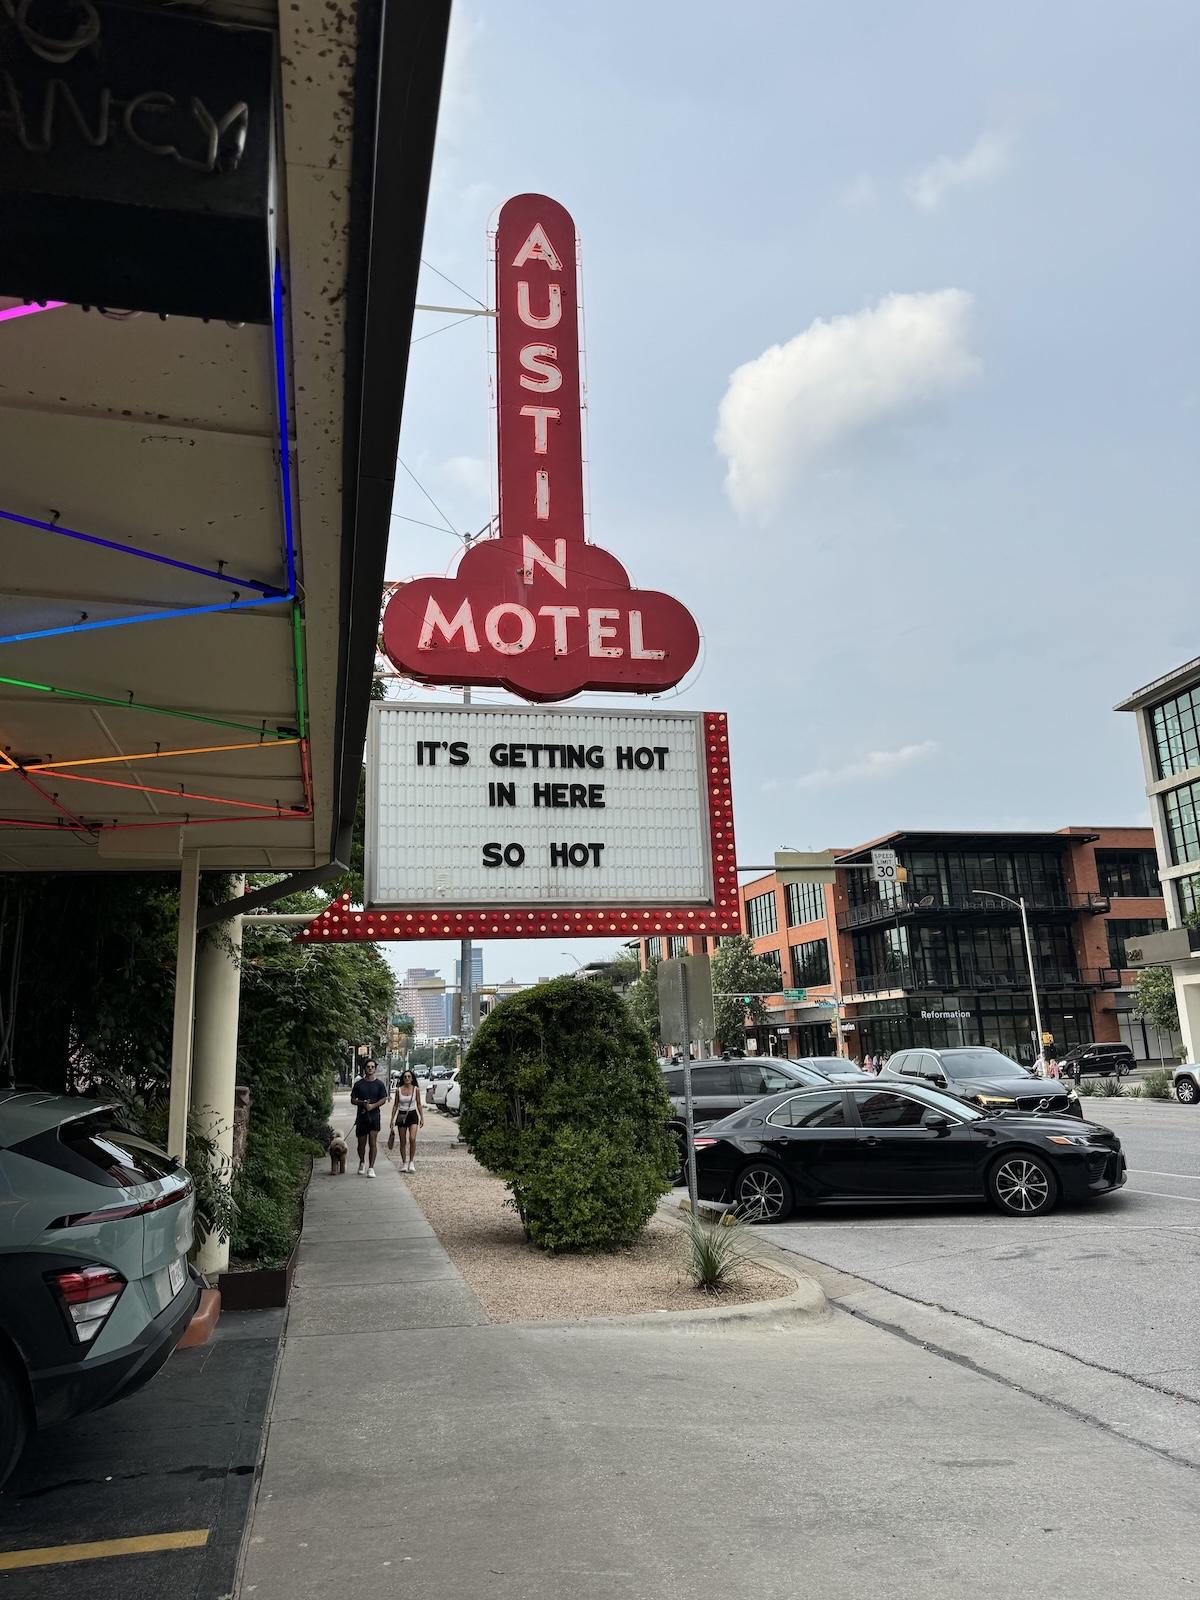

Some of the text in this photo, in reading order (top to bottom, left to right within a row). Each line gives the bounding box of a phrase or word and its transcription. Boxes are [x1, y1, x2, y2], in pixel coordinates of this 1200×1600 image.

[511, 222, 568, 590] AUSTIN
[416, 595, 667, 661] MOTEL
[416, 741, 669, 771] IT'S GETTING HOT
[488, 782, 606, 808] IN HERE
[482, 842, 605, 868] SO HOT
[877, 865, 894, 877] 30
[920, 1009, 971, 1019] Reformation
